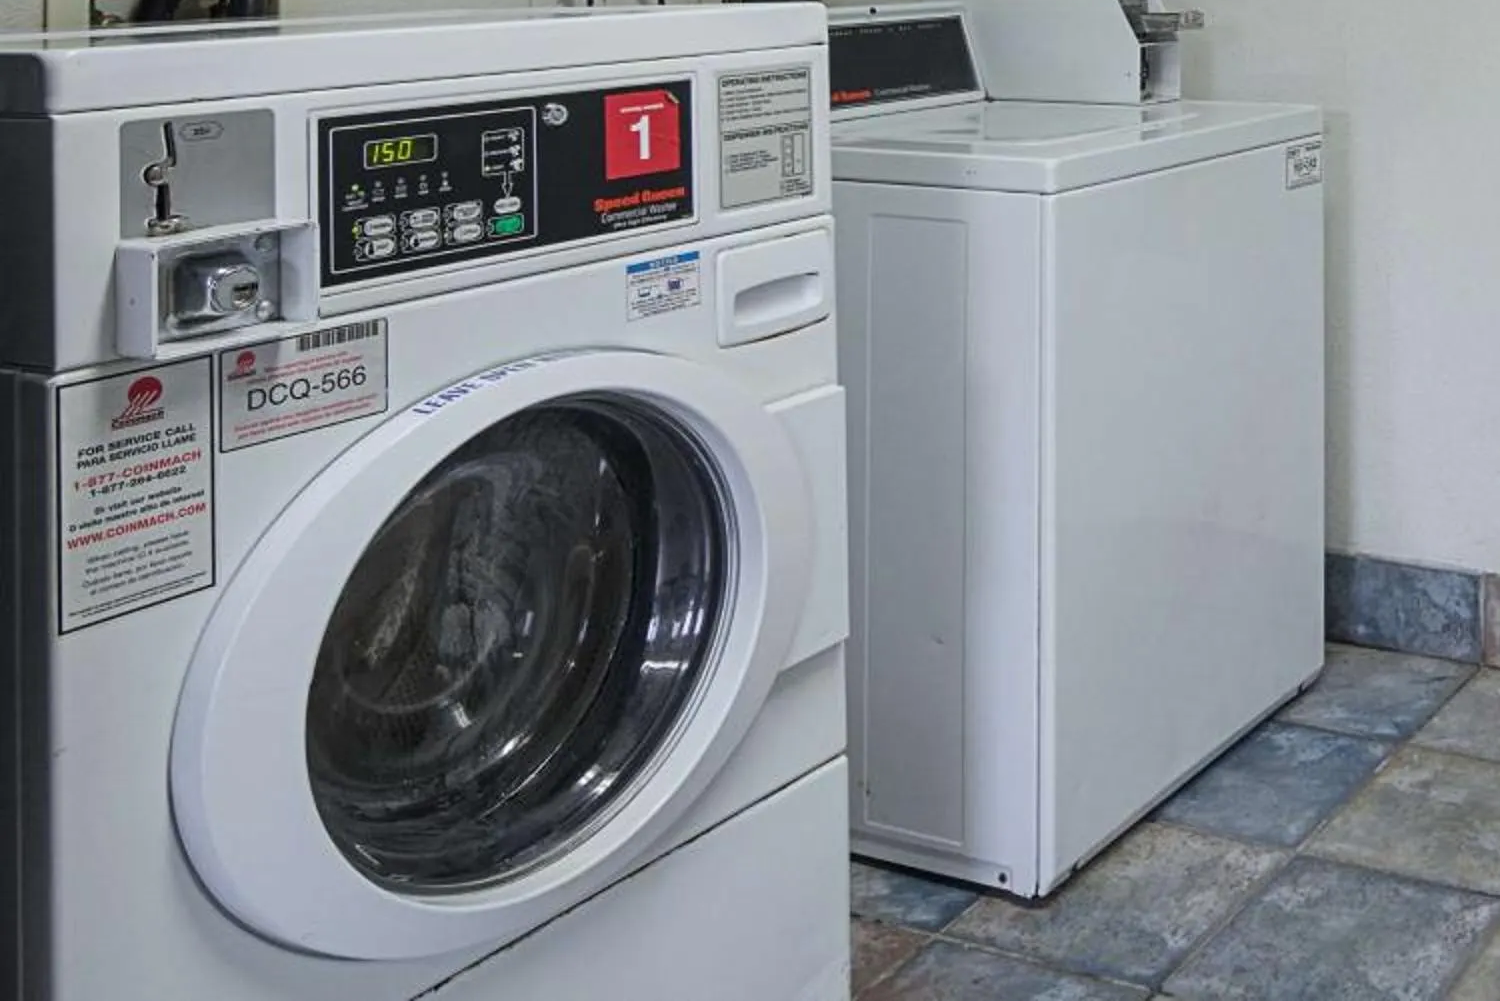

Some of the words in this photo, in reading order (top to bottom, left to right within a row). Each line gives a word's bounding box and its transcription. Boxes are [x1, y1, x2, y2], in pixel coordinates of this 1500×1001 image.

[372, 139, 412, 163] 150
[629, 114, 650, 160] 1
[247, 365, 367, 412] DCQ-566
[412, 381, 483, 415] LEAVE
[78, 444, 103, 457] FOR
[108, 431, 160, 450] SERVICE
[166, 422, 195, 436] CALL
[78, 455, 105, 469] PARA
[110, 442, 158, 461] SERVICIO
[162, 433, 195, 447] LLAME
[75, 450, 200, 490] 1-877-COINMACH
[68, 502, 205, 549] WWW.COINMACH.COM
